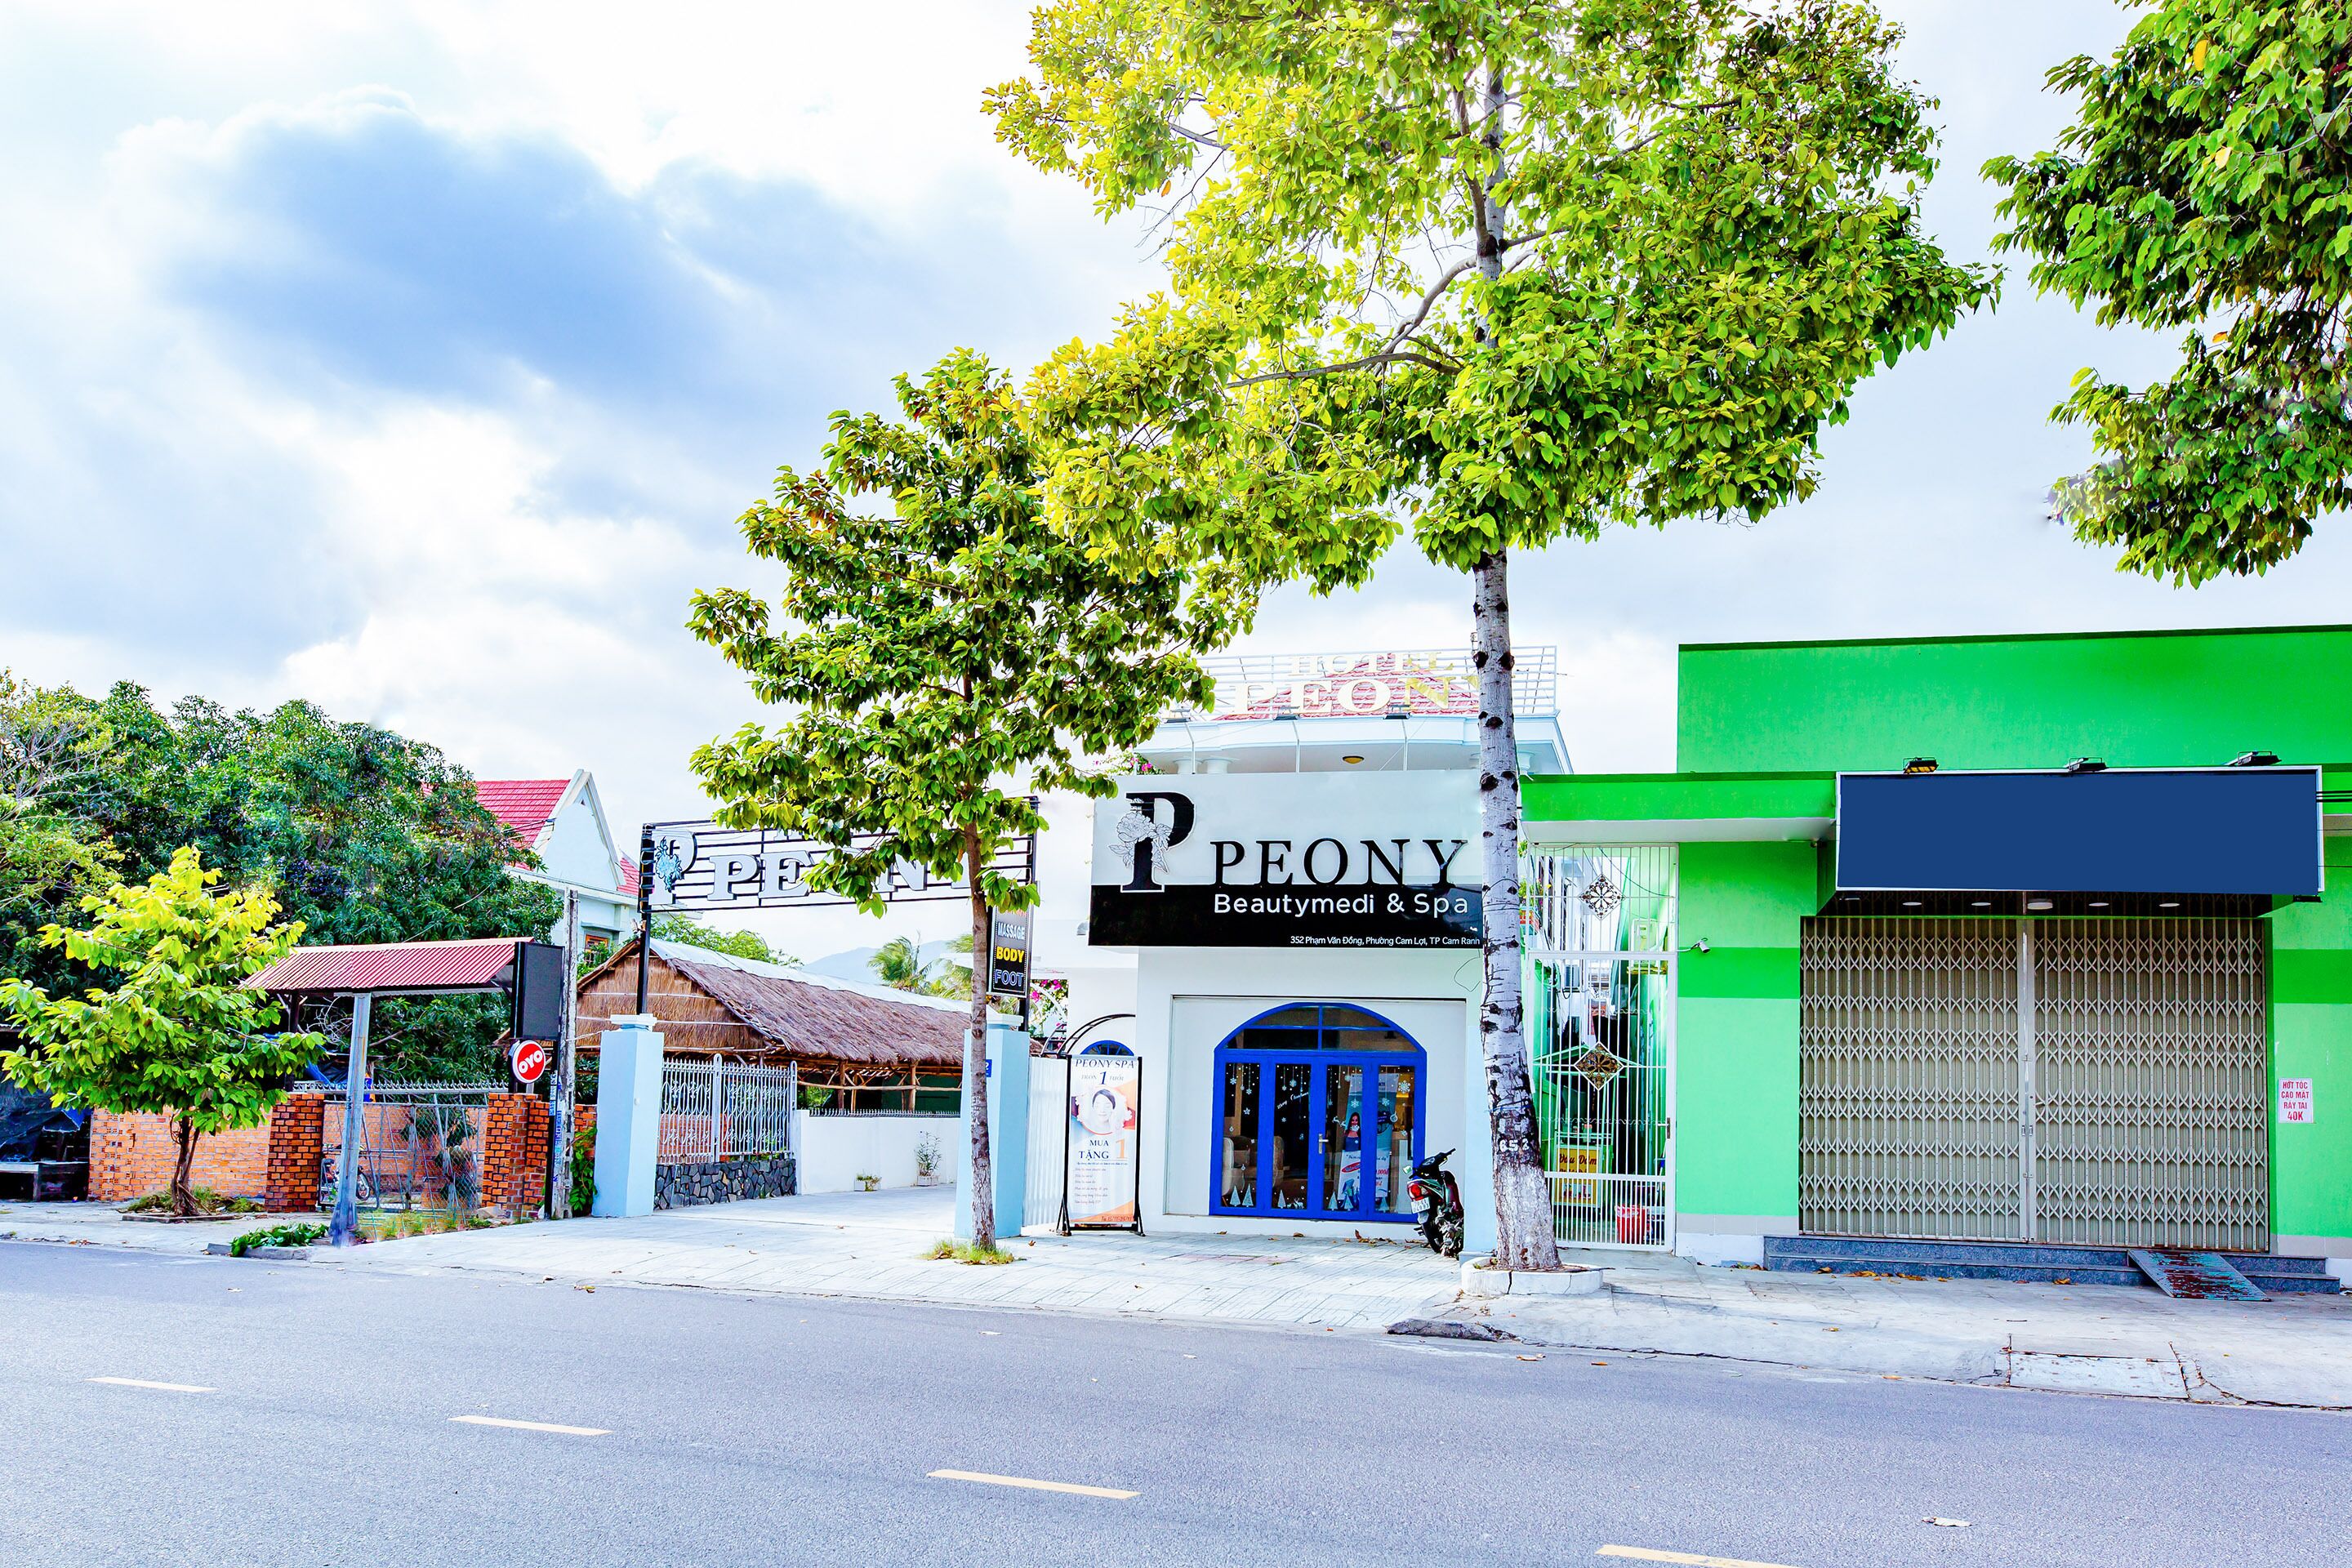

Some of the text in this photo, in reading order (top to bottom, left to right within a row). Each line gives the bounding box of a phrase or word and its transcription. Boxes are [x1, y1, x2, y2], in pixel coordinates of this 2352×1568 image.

[1288, 652, 1454, 676] HOTEL
[1229, 675, 1516, 715] PEON
[1120, 791, 1196, 893] P
[1210, 837, 1468, 887] PEONY
[706, 849, 972, 901] PEN
[1214, 893, 1468, 920] Beautymedi & Spa
[997, 921, 1026, 941] MASSAGE
[1290, 936, 1304, 944] 352
[1305, 936, 1325, 945] Phạm
[1365, 937, 1393, 946] Phường
[1395, 937, 1413, 945] Cam
[1429, 937, 1441, 945] TP
[1442, 937, 1460, 945] Cam
[1461, 937, 1481, 945] Ranh
[996, 946, 1025, 963] BODY
[994, 969, 1024, 987] FOOT
[518, 1049, 543, 1074] OYO
[1076, 1058, 1134, 1069] PEONY SPA
[1098, 1071, 1107, 1085] 1
[2287, 1111, 2303, 1120] 40K
[1078, 1149, 1109, 1160] TẶNG
[1116, 1138, 1128, 1159] 1
